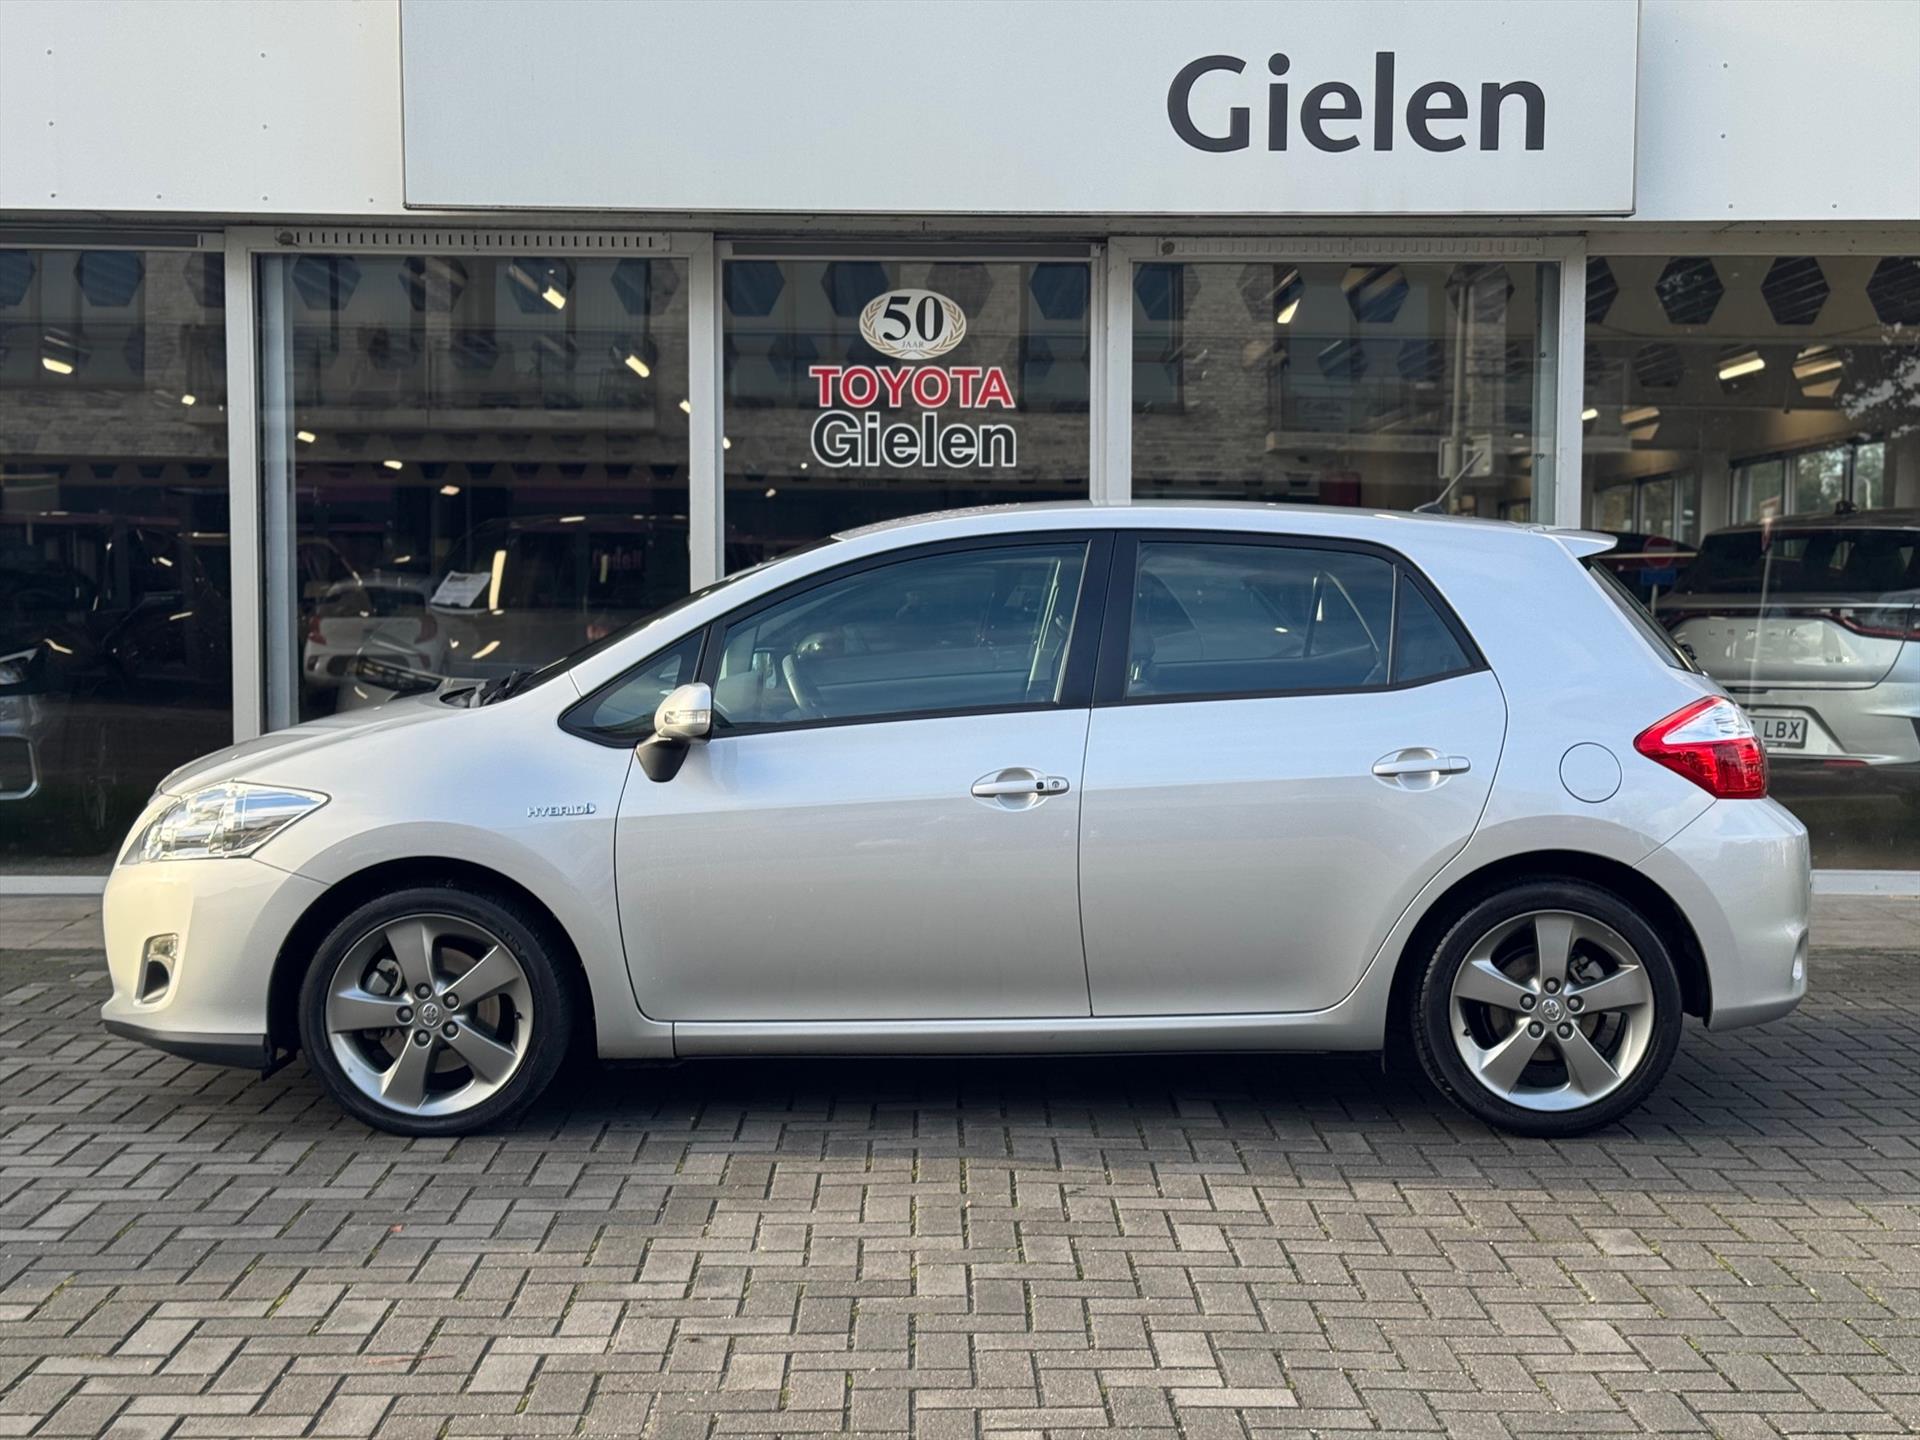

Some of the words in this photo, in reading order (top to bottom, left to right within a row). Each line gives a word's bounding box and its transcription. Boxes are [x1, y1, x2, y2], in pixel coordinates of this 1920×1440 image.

[1167, 51, 1546, 153] Gielen
[882, 295, 945, 342] 50
[809, 365, 1016, 409] TOYOTA
[810, 410, 1017, 468] Gielen
[1763, 720, 1801, 740] LBX
